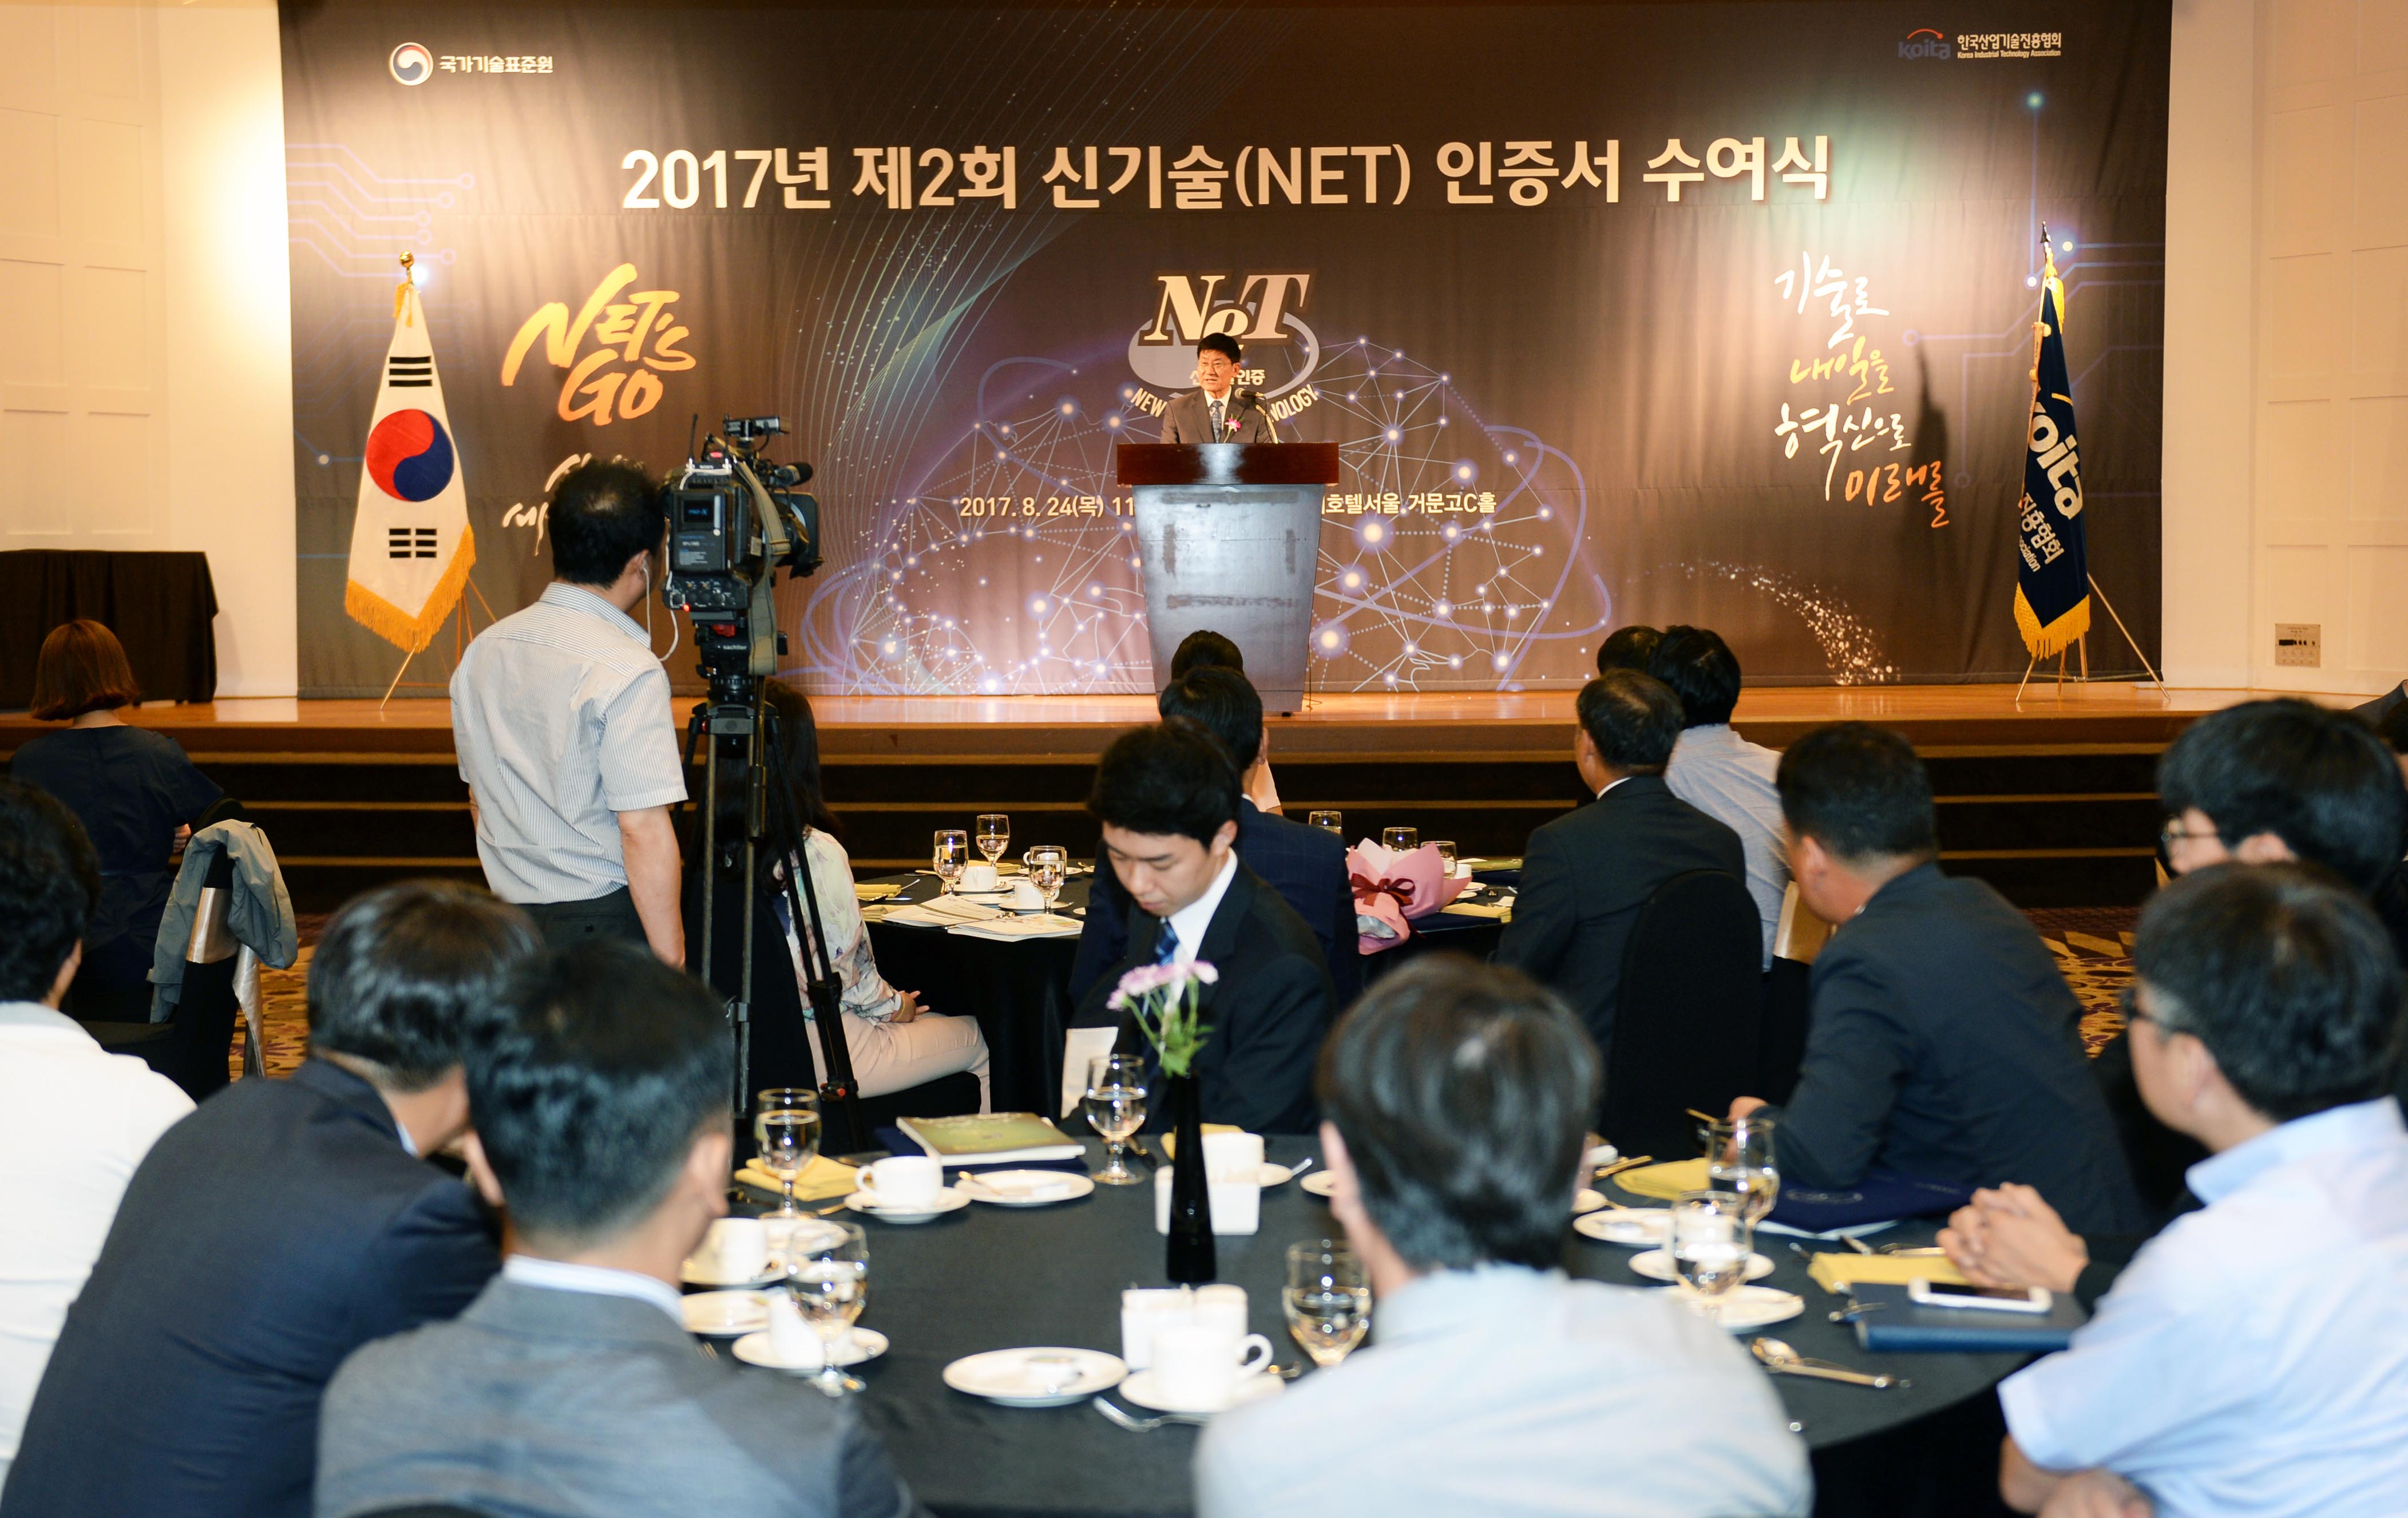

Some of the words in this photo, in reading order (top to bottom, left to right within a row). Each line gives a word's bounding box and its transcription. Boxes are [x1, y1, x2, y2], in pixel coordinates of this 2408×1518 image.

[1898, 39, 1951, 60] koita
[1957, 33, 2061, 50] 한국산업기술진흥협회
[2001, 50, 2030, 58] Technology
[439, 56, 553, 73] 국가기술표준원
[621, 147, 831, 209] 2017년
[852, 145, 1016, 209] 제2회
[1041, 144, 1411, 209] 신기술(NET)
[1436, 139, 1619, 207] 인증서
[1642, 135, 1829, 202] 수여식
[1775, 251, 1890, 349] 기술로
[1790, 335, 1894, 405] 내일을
[1131, 388, 1167, 418] NEW
[1269, 383, 1319, 423] NOLOGY
[1775, 402, 1912, 501] 혁신으로
[2029, 401, 2083, 520] oita
[960, 496, 1017, 516] 2017.
[1022, 496, 1041, 517] 8.
[1047, 495, 1104, 517] 24(목)
[1321, 492, 1401, 515] 호텔서울
[1408, 492, 1497, 514] 거문고C홀
[1845, 460, 1949, 528] 미래를
